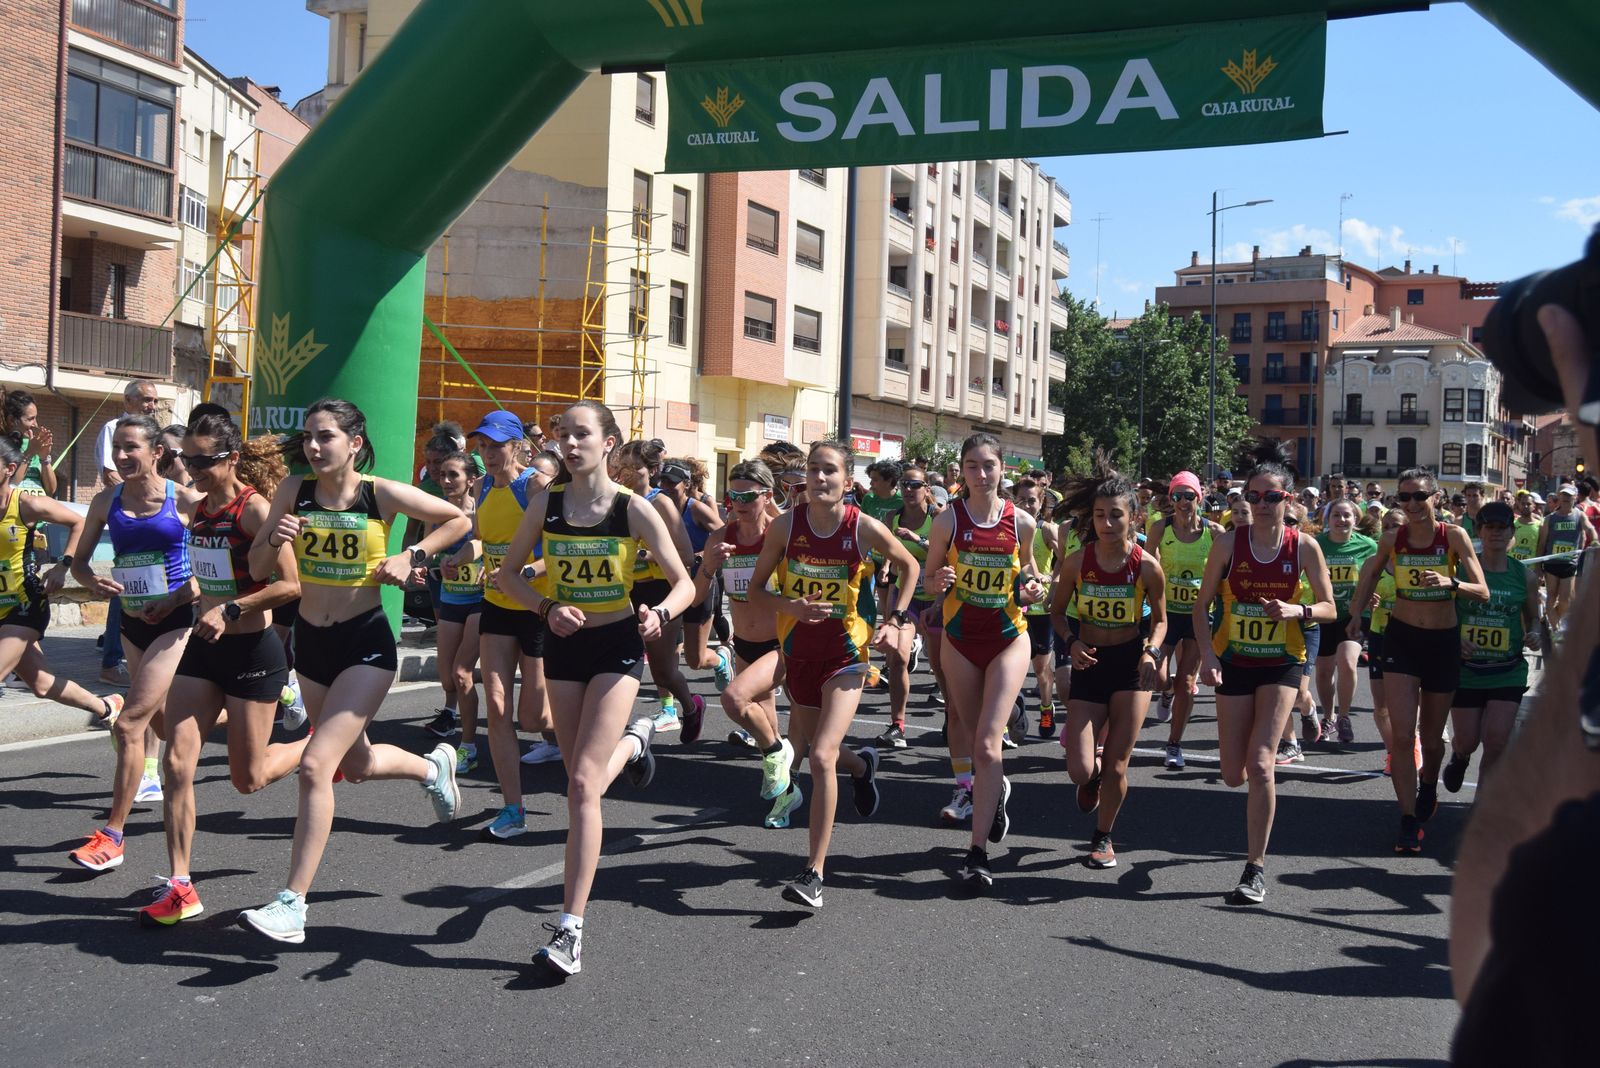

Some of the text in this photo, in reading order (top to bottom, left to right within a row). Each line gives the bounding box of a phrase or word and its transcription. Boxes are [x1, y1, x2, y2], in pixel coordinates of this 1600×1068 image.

[776, 58, 1180, 143] SALIDA
[1201, 96, 1295, 117] CAJA RURAL
[687, 130, 760, 146] CAJA RURAL
[315, 520, 358, 529] CAJA RURAL
[302, 531, 359, 560] 248
[586, 548, 609, 556] RURAL
[195, 561, 219, 578] MARTA
[316, 566, 362, 576] CAJA RURAL
[558, 559, 614, 584] 244
[123, 577, 149, 595] MARÍA
[792, 578, 841, 602] 402
[961, 569, 1005, 592] 404
[573, 589, 621, 599] CAJA RURAL
[1171, 586, 1199, 602] 103
[1084, 599, 1126, 620] 136
[1236, 619, 1280, 642] 107
[1466, 627, 1502, 648] 150
[246, 670, 267, 678] asics
